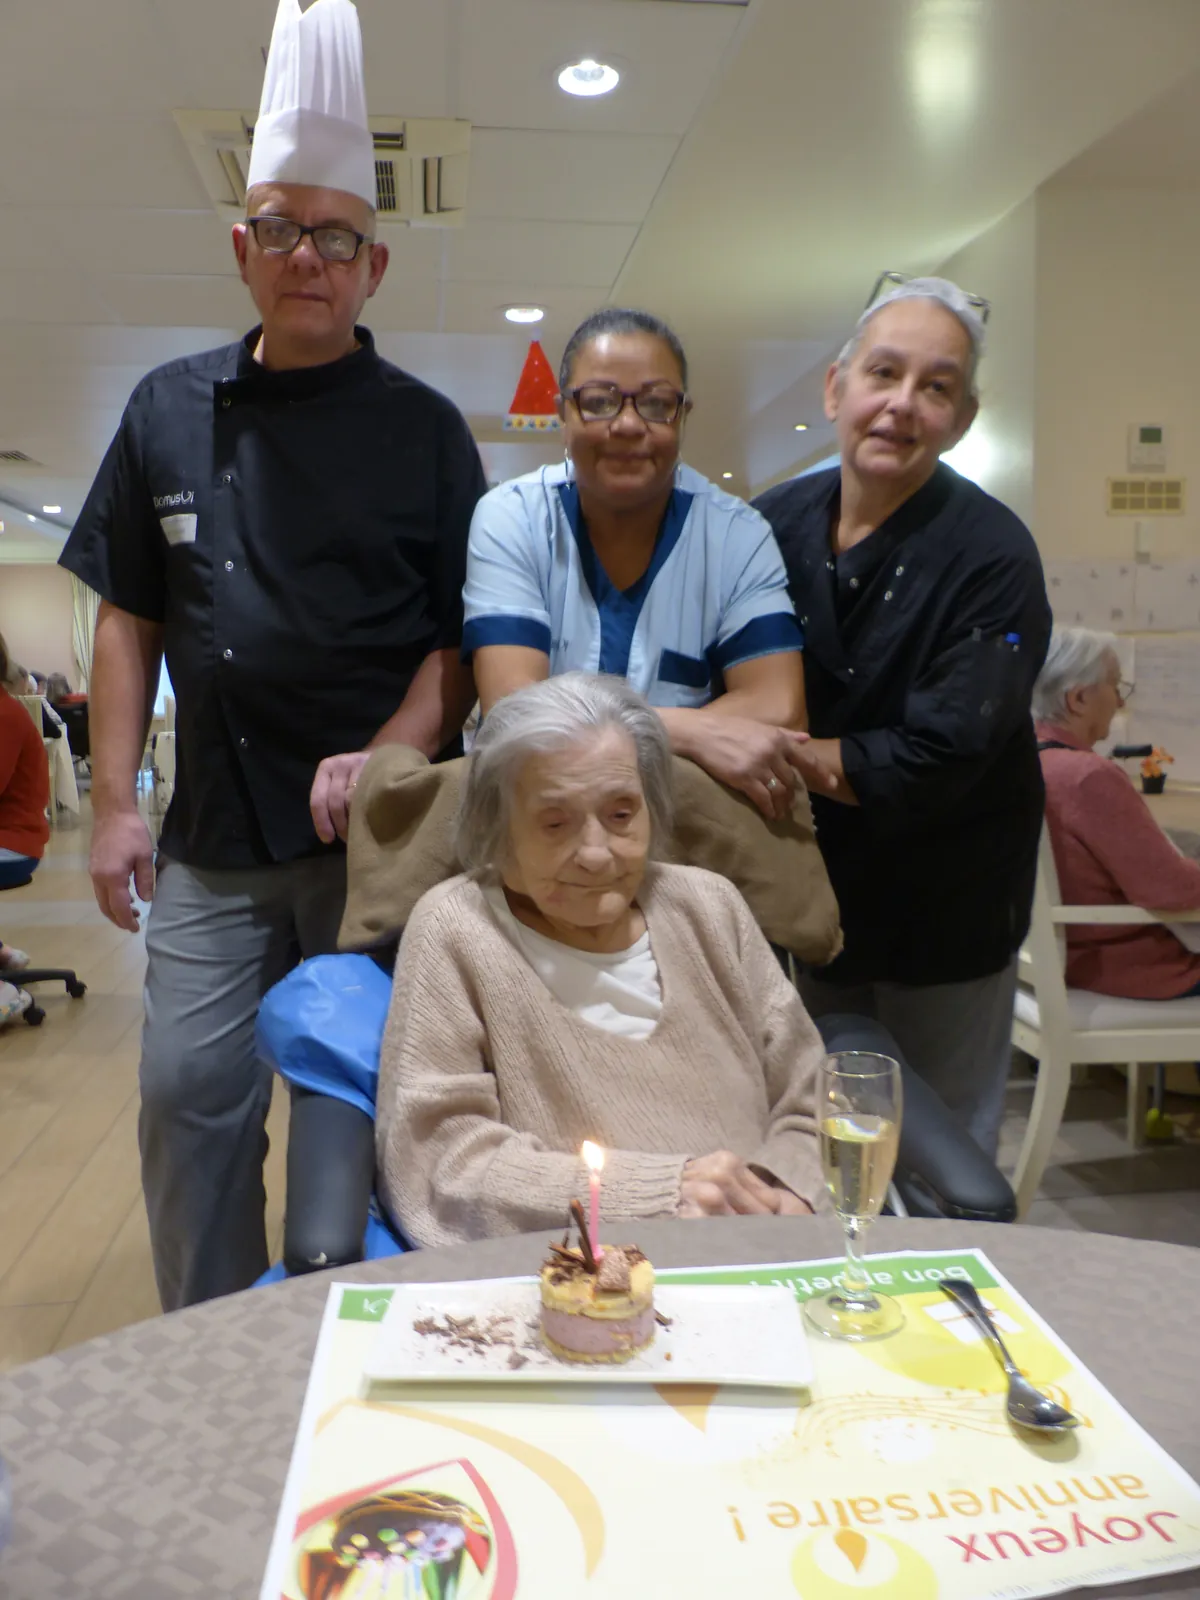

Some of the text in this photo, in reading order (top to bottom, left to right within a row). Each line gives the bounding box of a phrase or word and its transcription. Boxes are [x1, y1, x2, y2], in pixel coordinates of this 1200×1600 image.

[726, 1473, 1151, 1543] anniversaire !
[945, 1510, 1180, 1563] Joyeux
